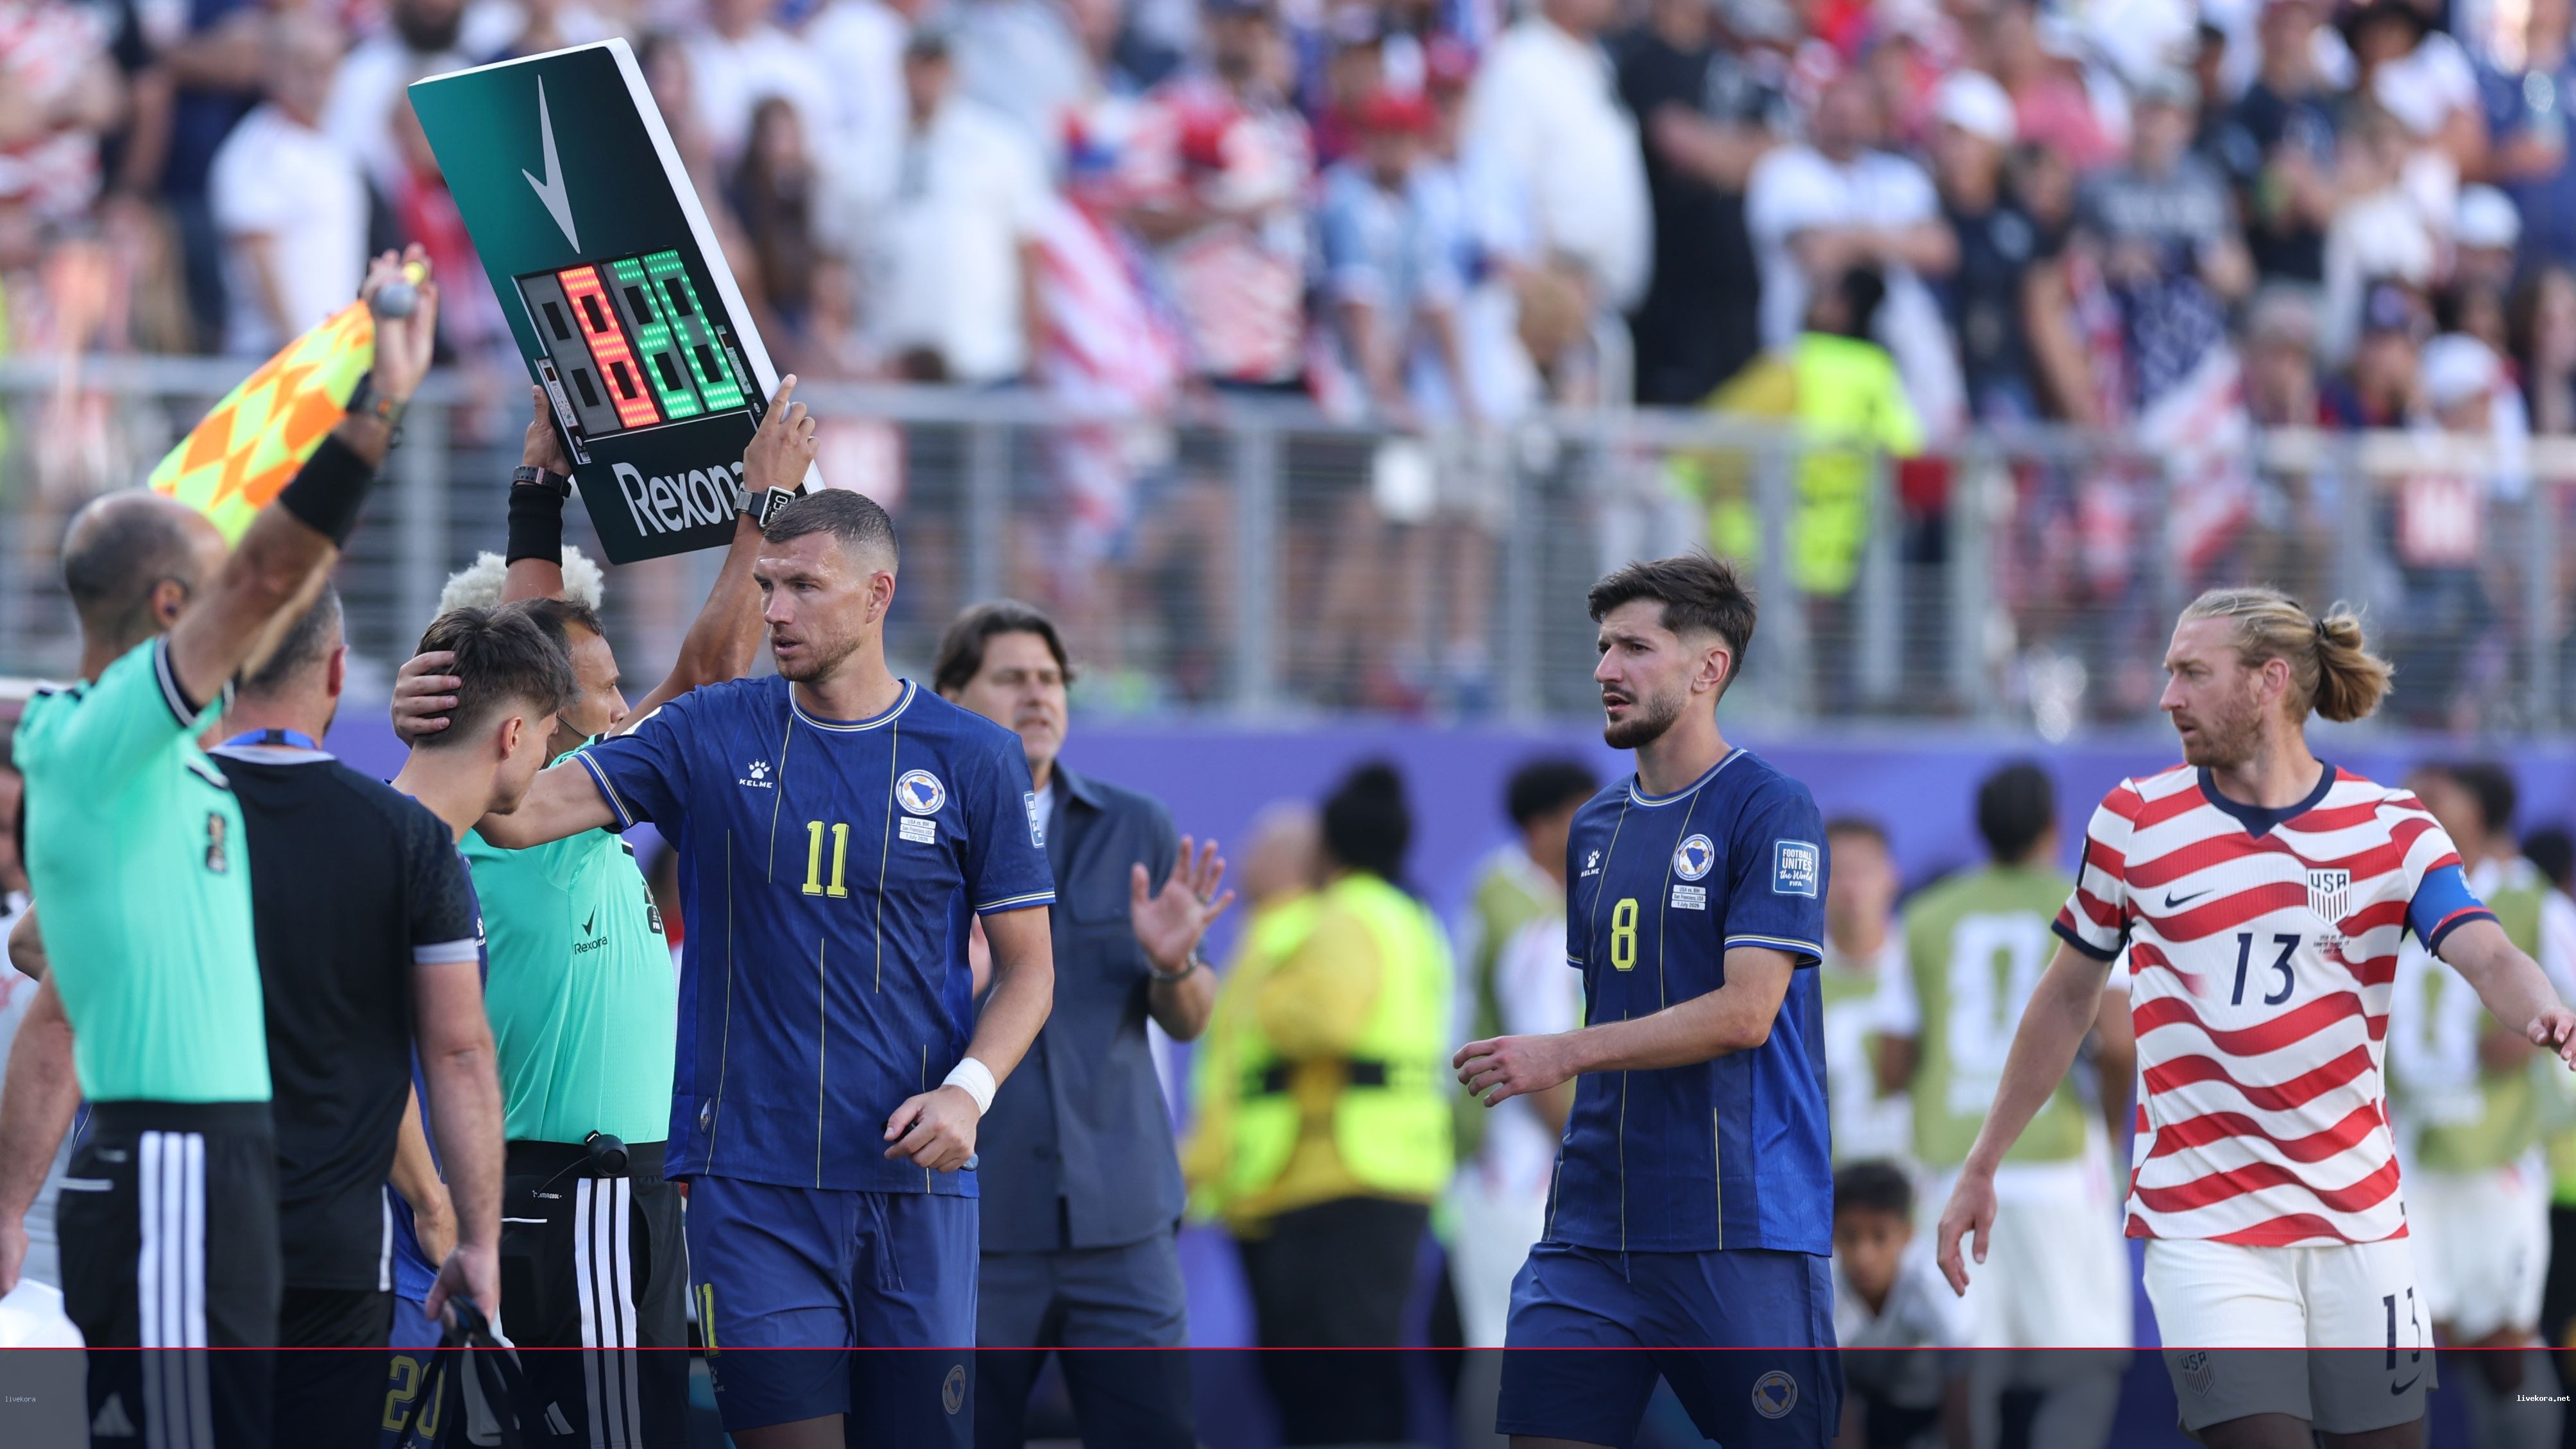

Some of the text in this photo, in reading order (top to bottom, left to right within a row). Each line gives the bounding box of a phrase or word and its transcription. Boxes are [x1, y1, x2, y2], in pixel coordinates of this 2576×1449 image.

[557, 266, 661, 428] 8
[613, 249, 745, 419] 20
[739, 779, 773, 788] KELME
[802, 821, 849, 898] 11
[1580, 868, 1600, 877] KELME
[1779, 869, 1813, 883] the World
[1782, 858, 1812, 872] UNITES
[1783, 849, 1812, 861] FOOTBALL
[2310, 873, 2346, 893] USA
[1611, 898, 1639, 971] 8
[2231, 933, 2301, 1006] 13
[2383, 1285, 2421, 1371] 13
[2181, 1351, 2207, 1371] USA
[382, 1355, 444, 1440] 20
